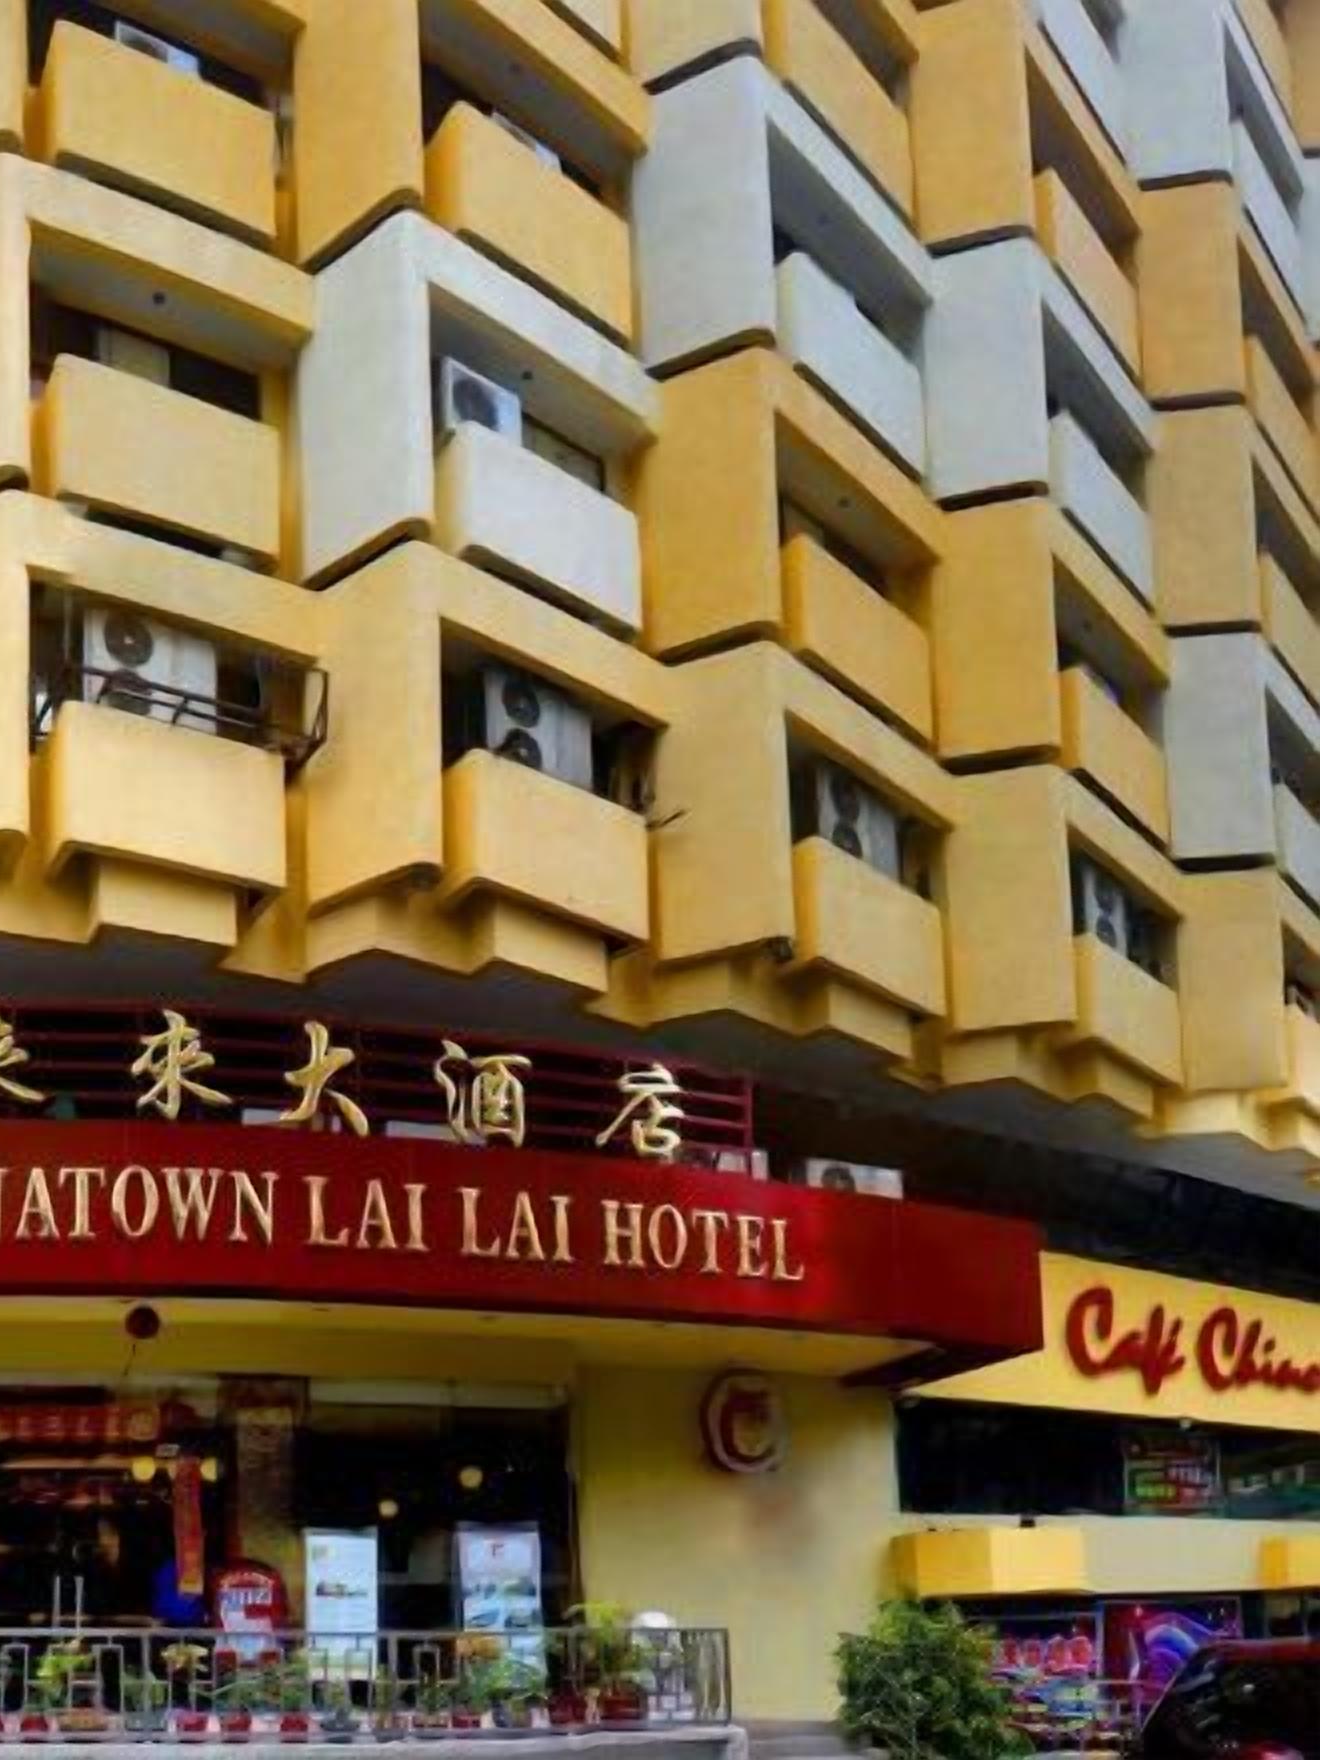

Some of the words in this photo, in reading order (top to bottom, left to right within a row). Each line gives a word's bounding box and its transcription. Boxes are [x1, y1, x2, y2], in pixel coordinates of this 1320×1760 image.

[302, 1175, 430, 1252] LAI
[458, 1186, 576, 1264] LAI
[601, 1199, 805, 1281] HOTEL
